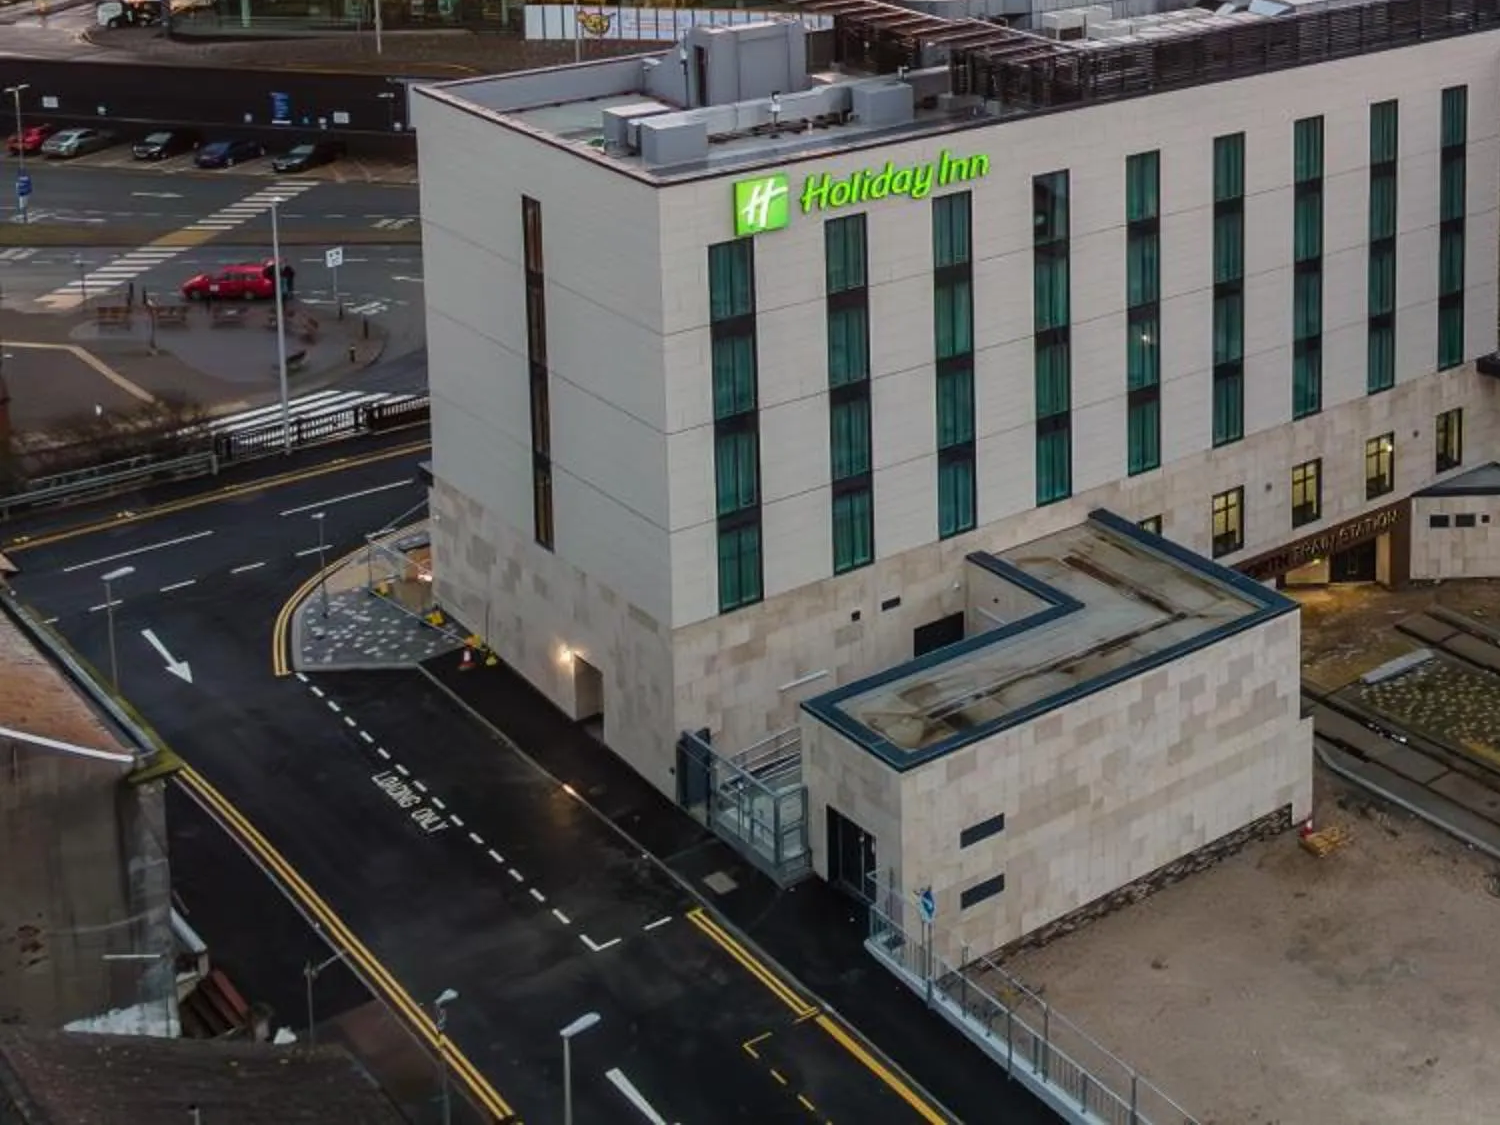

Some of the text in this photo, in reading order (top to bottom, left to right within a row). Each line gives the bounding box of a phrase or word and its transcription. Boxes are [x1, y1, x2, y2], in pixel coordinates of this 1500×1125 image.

[801, 149, 991, 214] Holiday Inn
[411, 808, 449, 834] ONLY
